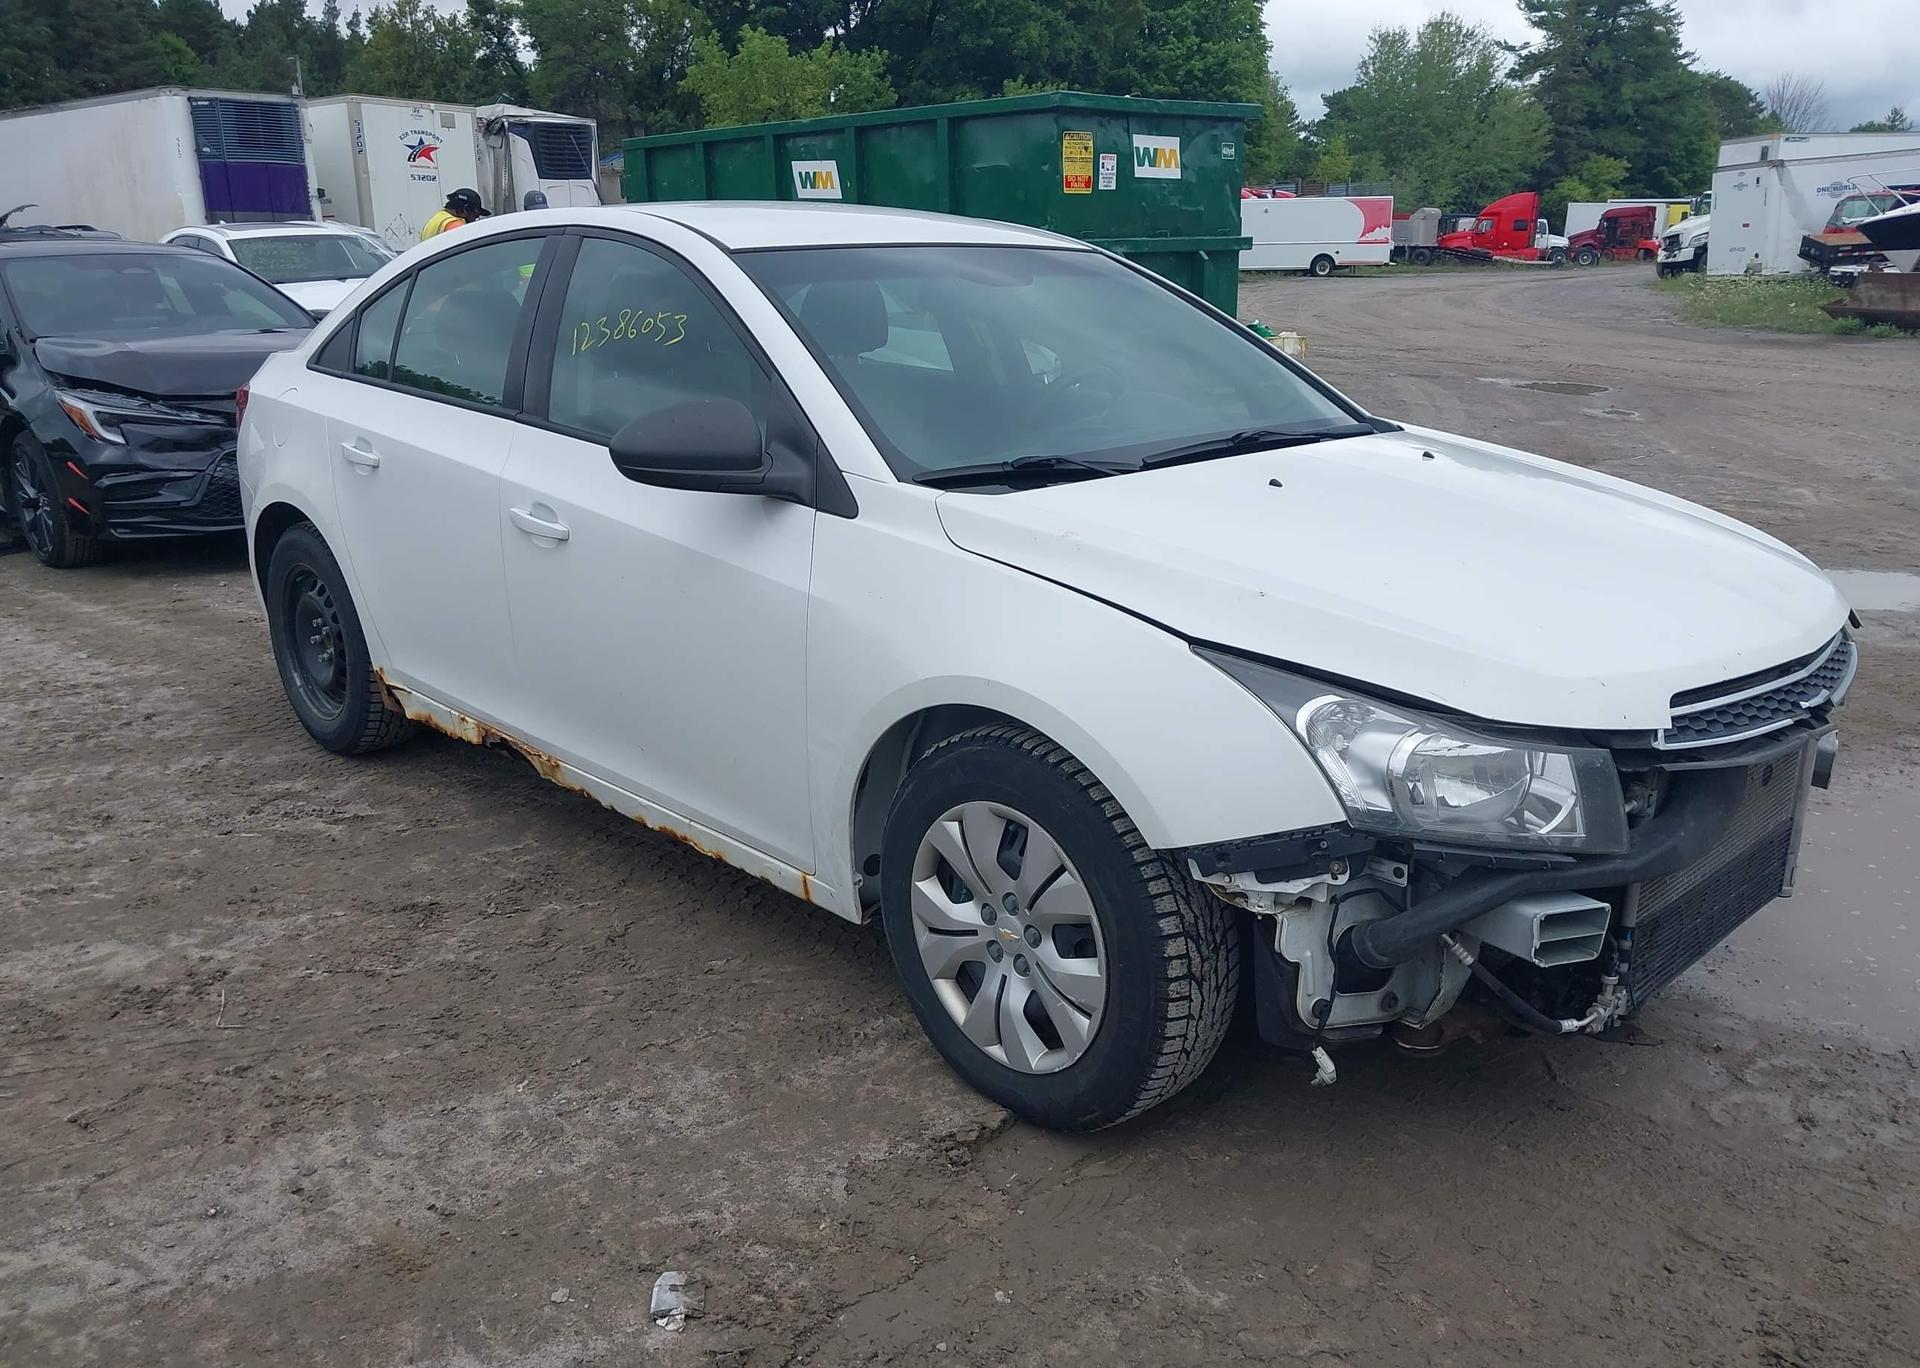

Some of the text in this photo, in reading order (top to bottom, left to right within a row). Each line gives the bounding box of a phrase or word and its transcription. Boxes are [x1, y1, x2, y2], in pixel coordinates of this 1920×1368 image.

[354, 120, 364, 155] 53202
[410, 129, 444, 144] TRANSPORT
[1069, 133, 1092, 141] CAUTION
[1135, 146, 1180, 169] WM
[410, 173, 438, 182] 53202
[798, 171, 835, 190] WM
[1816, 183, 1857, 193] ONE WORLD
[572, 309, 688, 356] 12386053
